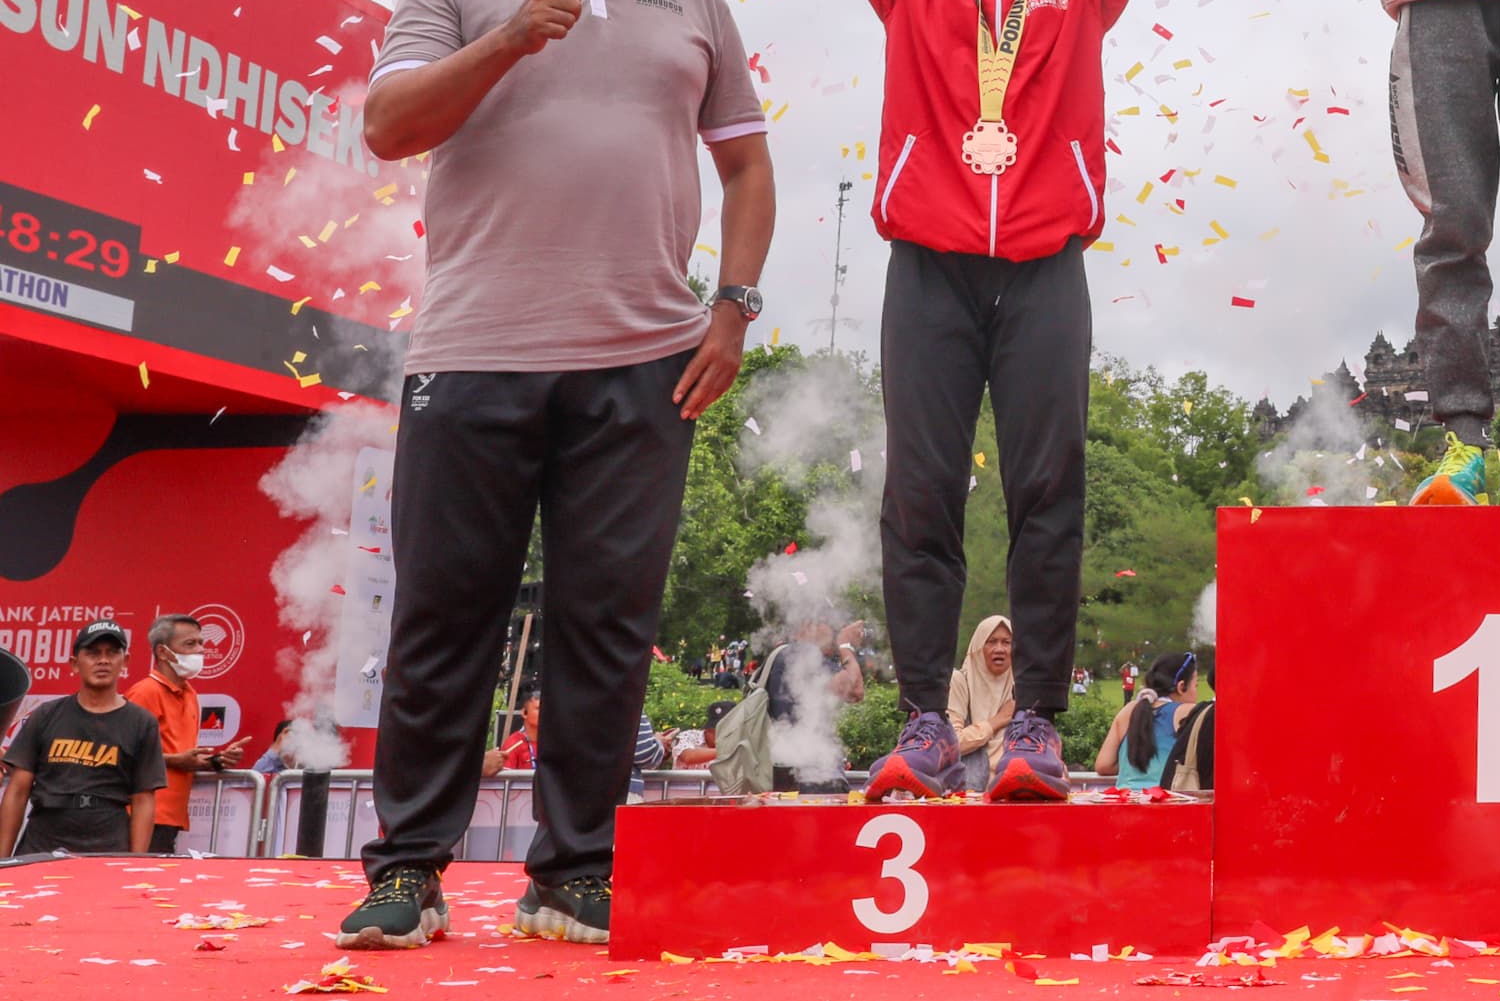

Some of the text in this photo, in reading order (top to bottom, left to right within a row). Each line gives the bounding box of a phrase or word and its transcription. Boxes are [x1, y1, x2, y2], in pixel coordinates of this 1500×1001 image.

[0, 203, 130, 278] 8:29
[0, 266, 69, 308] THON
[37, 606, 115, 626] JATENG
[48, 738, 119, 767] MULIA
[851, 813, 929, 935] 3
